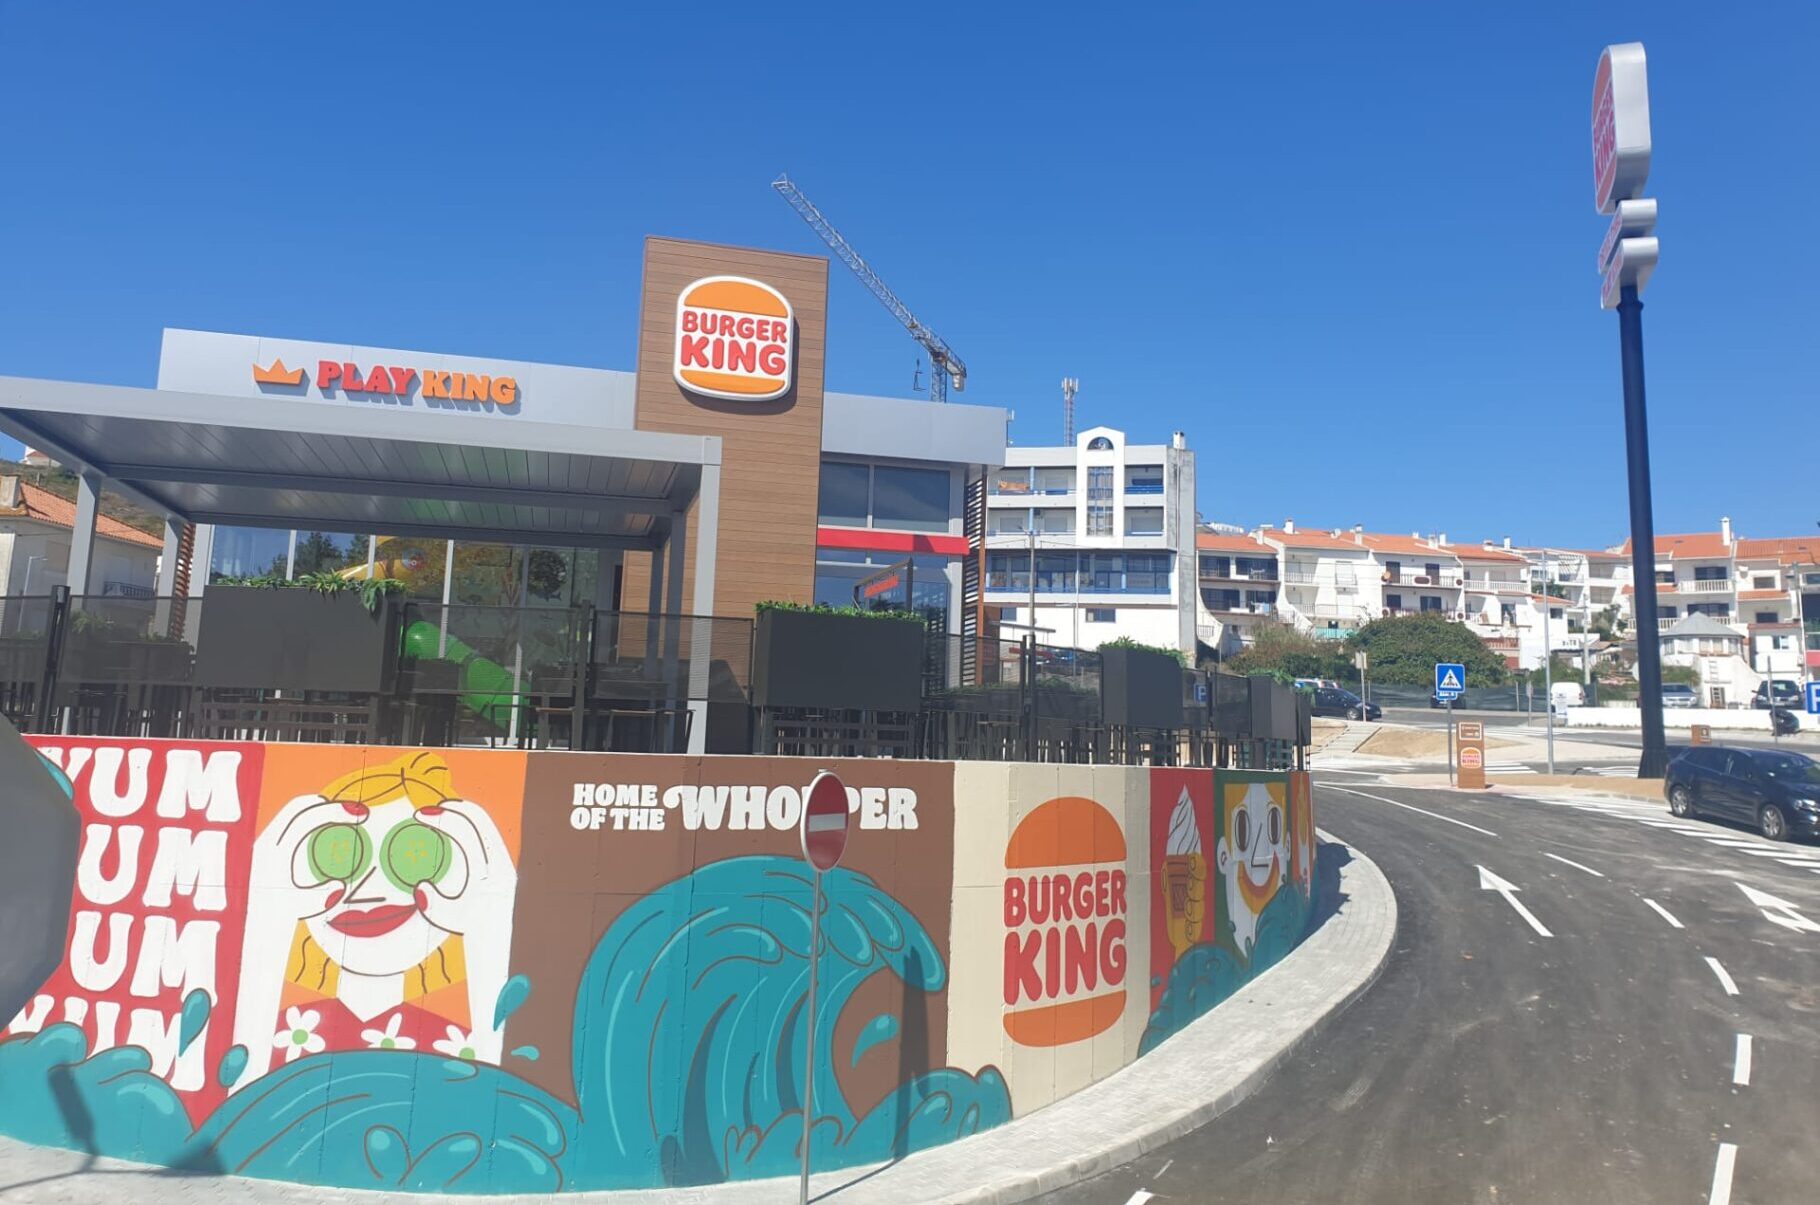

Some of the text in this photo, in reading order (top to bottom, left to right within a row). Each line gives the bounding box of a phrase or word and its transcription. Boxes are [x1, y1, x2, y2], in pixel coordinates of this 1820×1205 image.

[682, 310, 787, 343] BURGER
[681, 334, 786, 376] KING
[317, 360, 516, 405] PLAY KING
[573, 783, 658, 806] HOME
[663, 785, 919, 831] WHOER
[570, 807, 665, 830] OF THE
[78, 823, 228, 911] UM
[1004, 869, 1127, 927] BURGER
[70, 911, 220, 1007] UM
[1004, 918, 1127, 1006] KING
